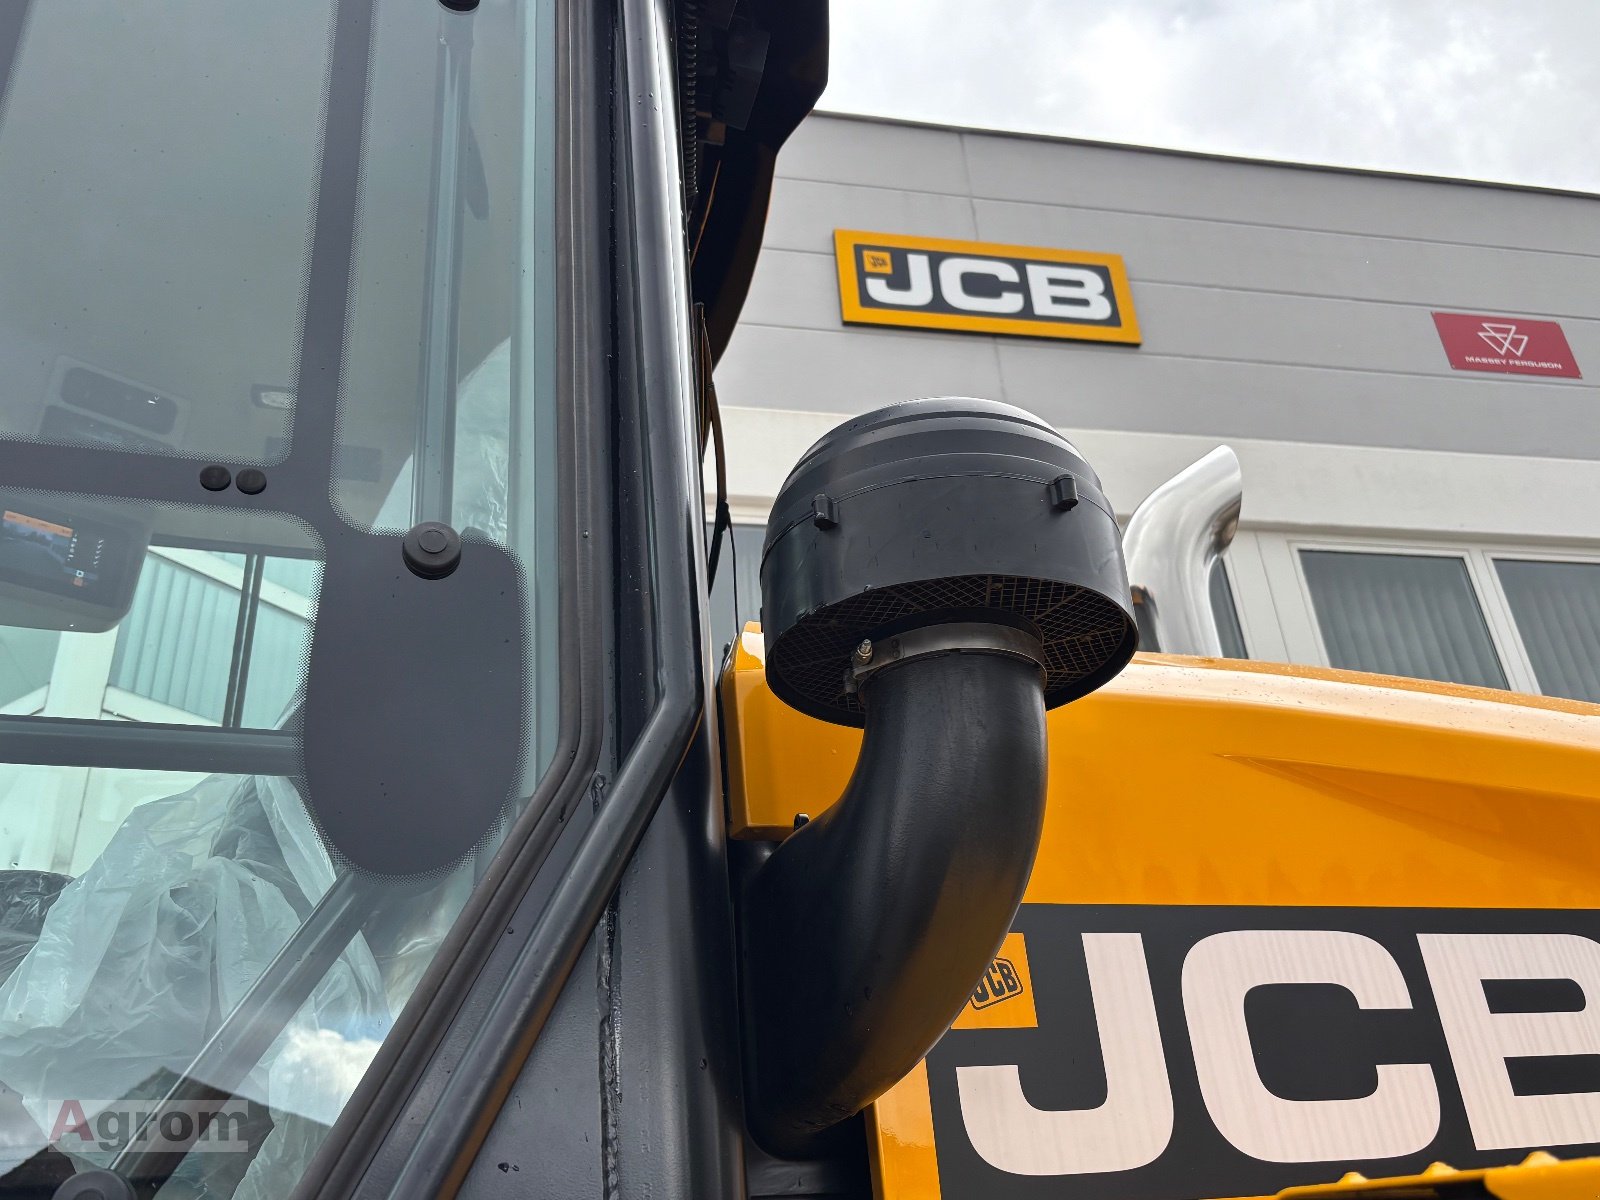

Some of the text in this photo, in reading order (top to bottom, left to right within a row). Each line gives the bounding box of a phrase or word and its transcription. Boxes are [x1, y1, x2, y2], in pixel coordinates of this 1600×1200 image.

[866, 254, 1112, 320] JCB
[1465, 355, 1562, 370] MASSEY FERGUSON
[956, 930, 1600, 1176] JCB
